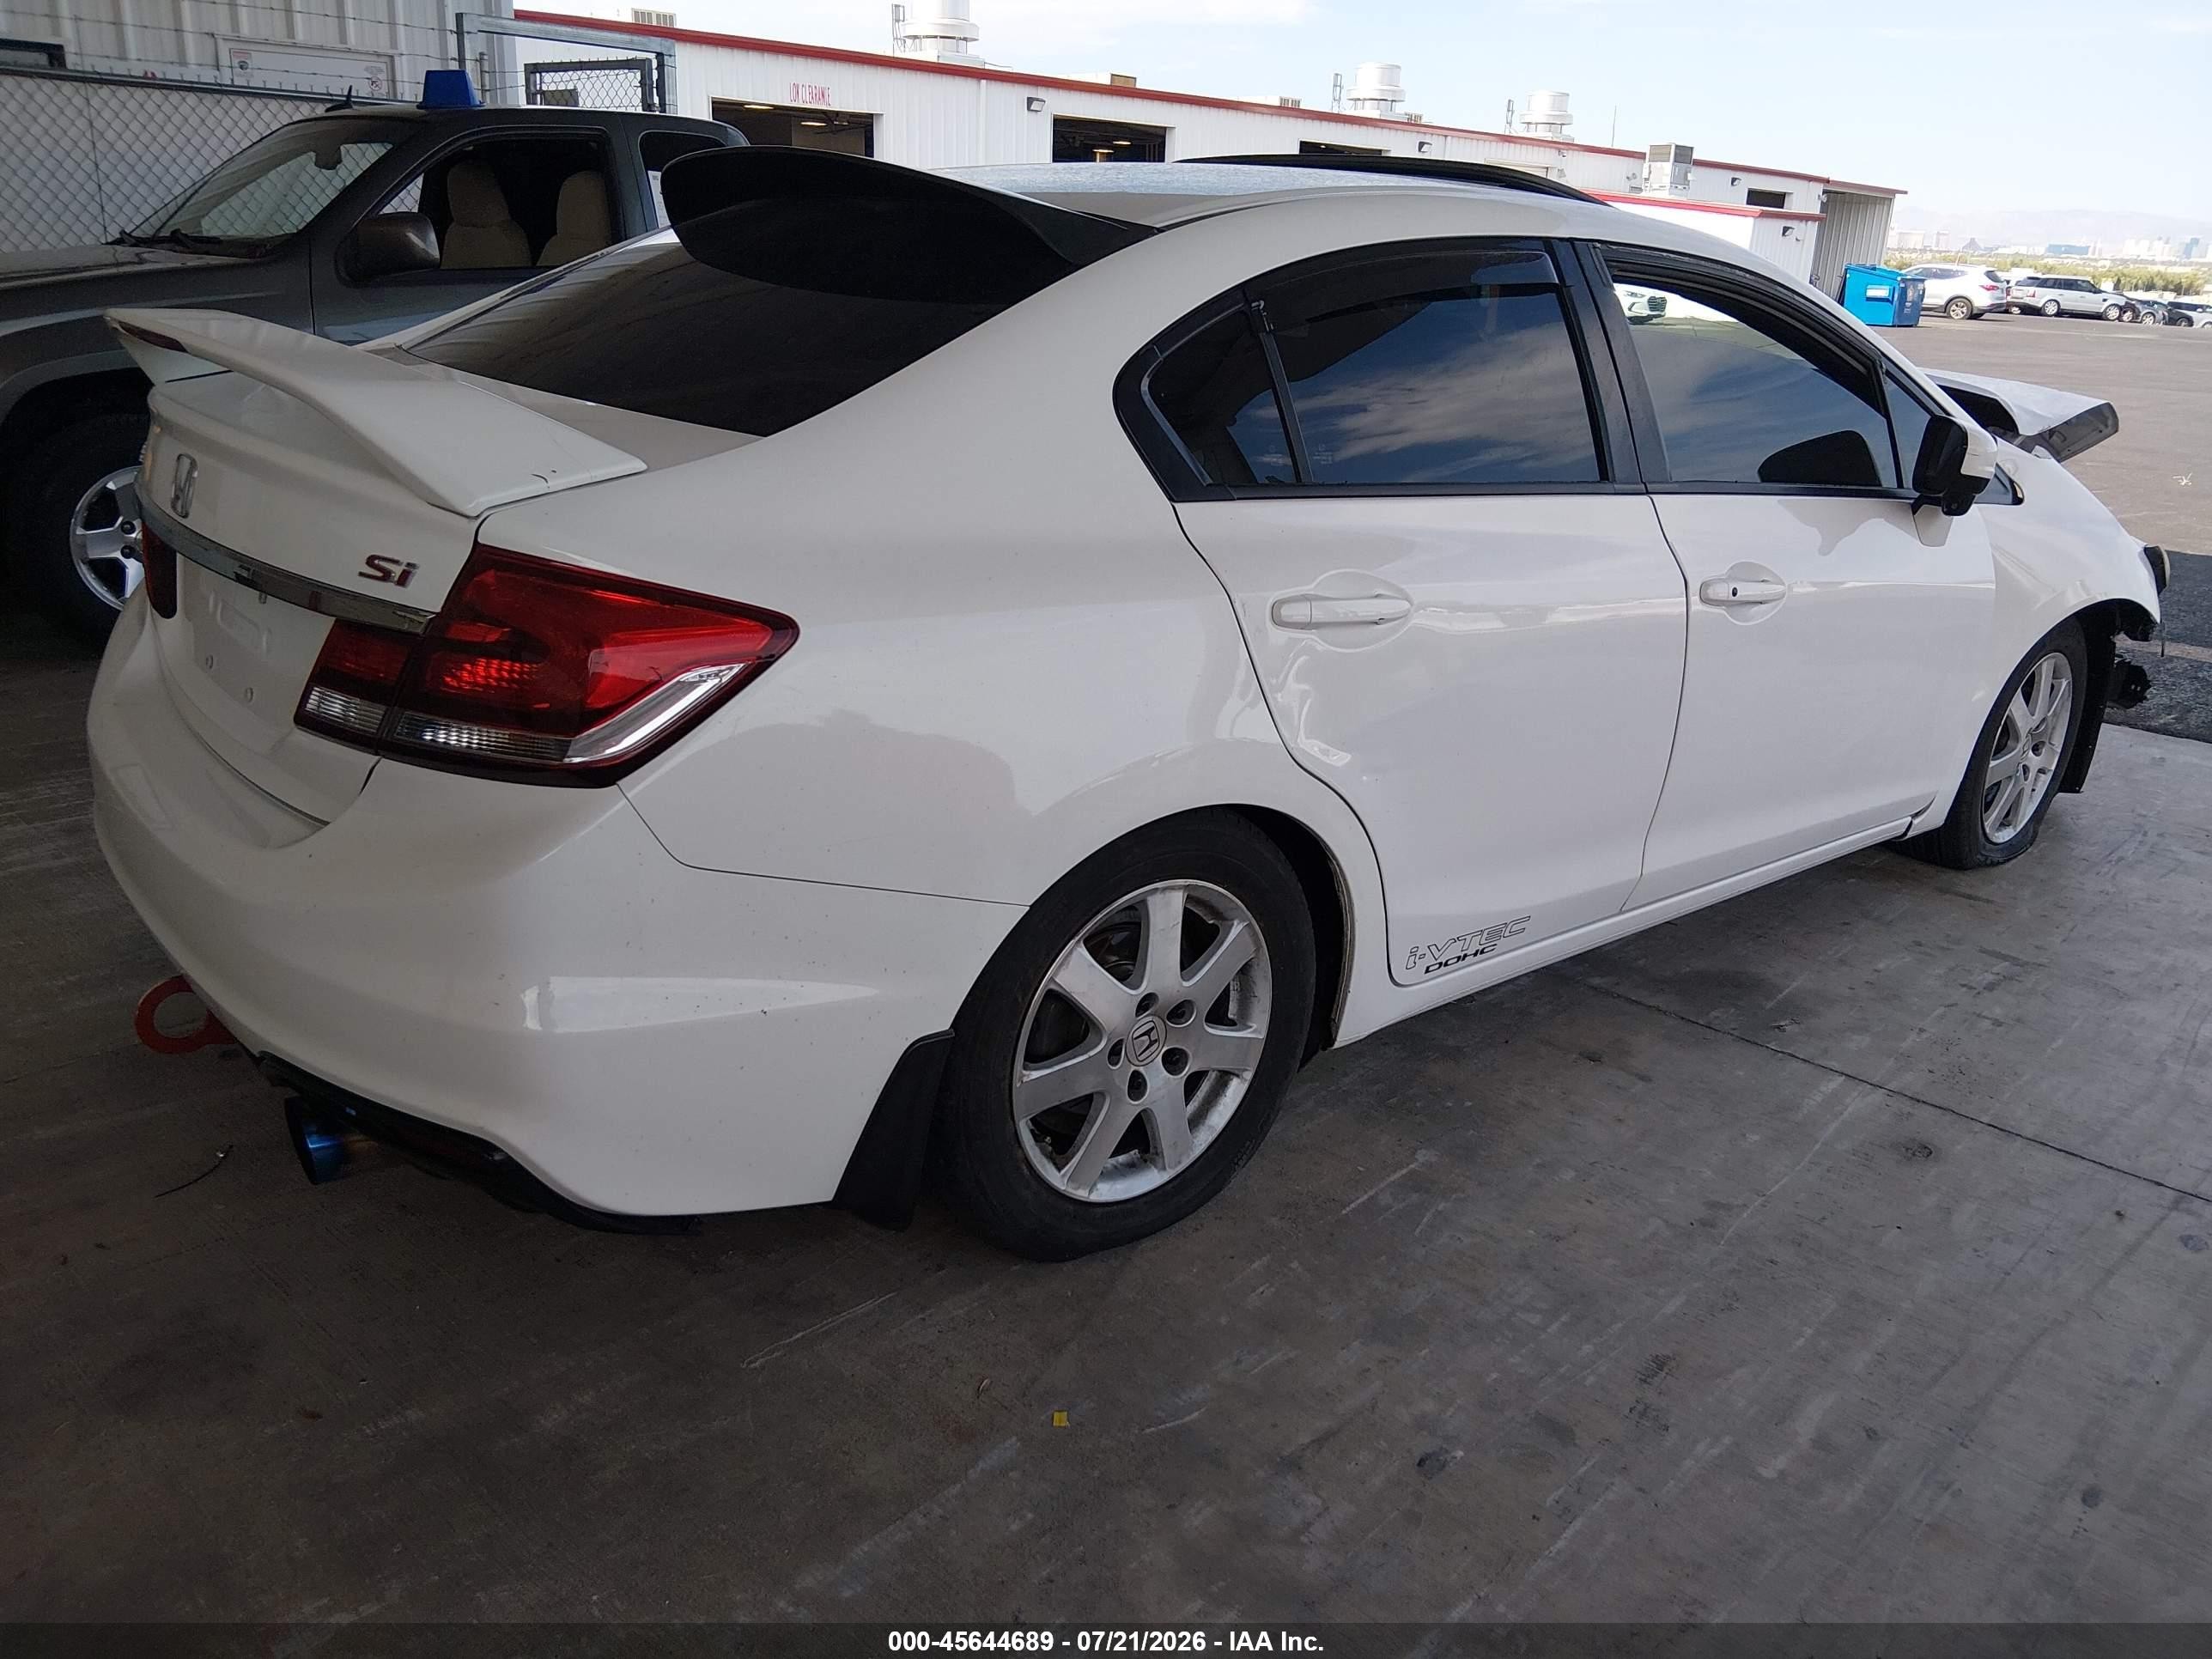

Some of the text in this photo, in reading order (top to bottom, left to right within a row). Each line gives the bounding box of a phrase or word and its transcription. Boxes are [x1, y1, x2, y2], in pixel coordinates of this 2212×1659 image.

[357, 554, 419, 588] Si
[1405, 915, 1531, 969] i-VTEC
[1424, 943, 1498, 975] DOHC
